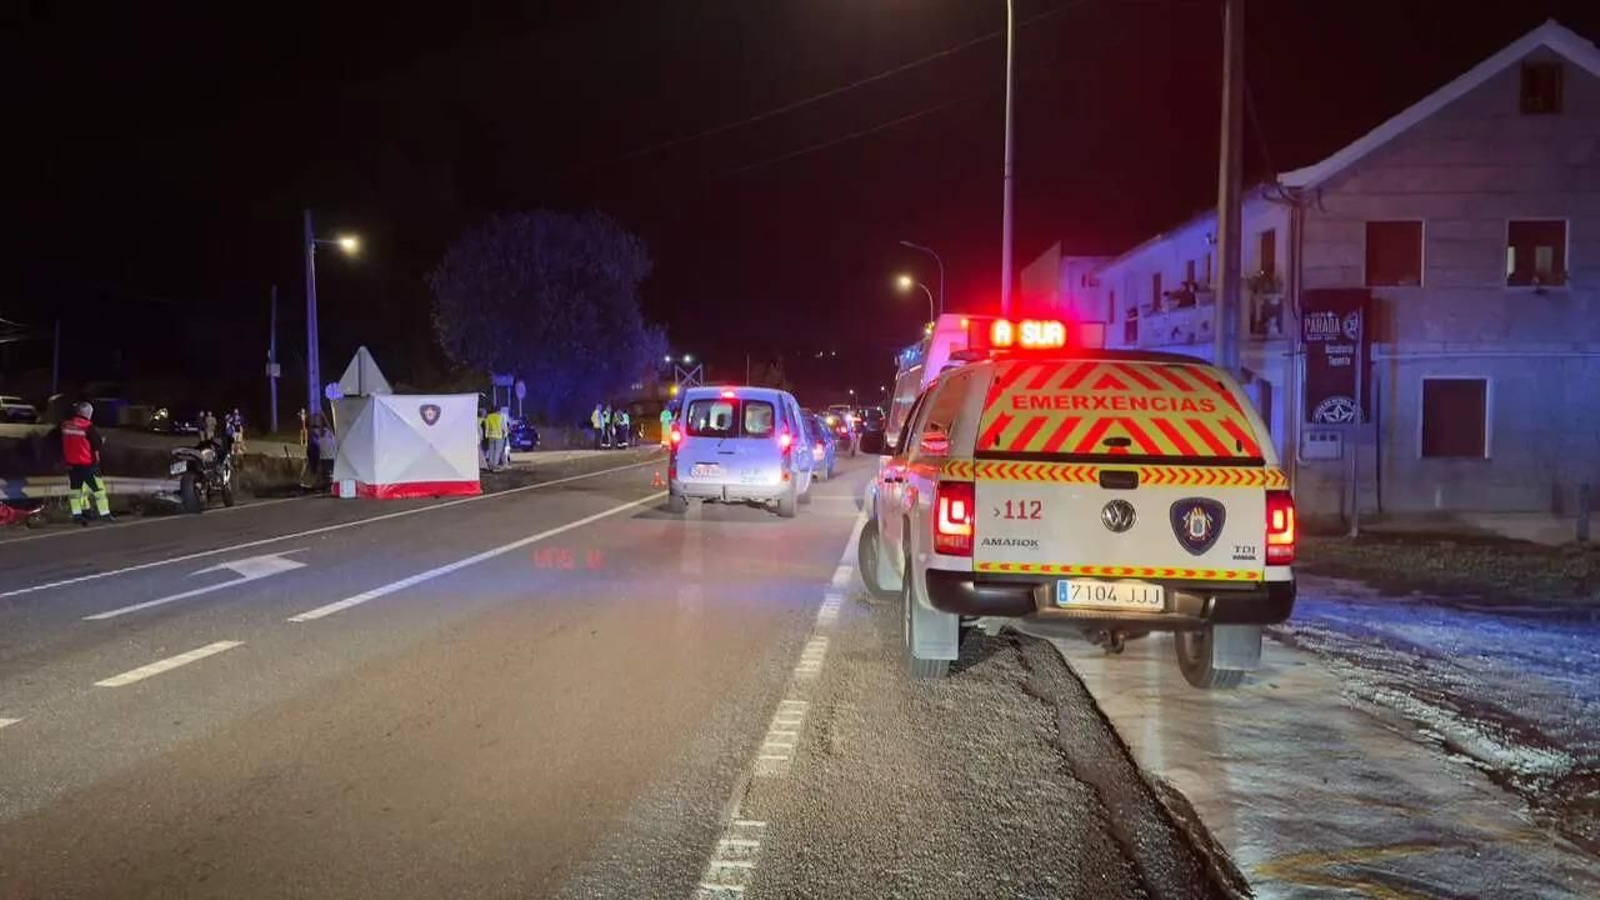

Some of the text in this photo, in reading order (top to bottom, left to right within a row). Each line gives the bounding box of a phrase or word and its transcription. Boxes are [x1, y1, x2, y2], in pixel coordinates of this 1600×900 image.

[1021, 320, 1064, 346] SUR
[1011, 394, 1216, 413] EMERXENCIAS
[981, 537, 1039, 548] AMAROK
[1234, 545, 1256, 555] TDI
[1071, 584, 1160, 605] 7104 JJJ
